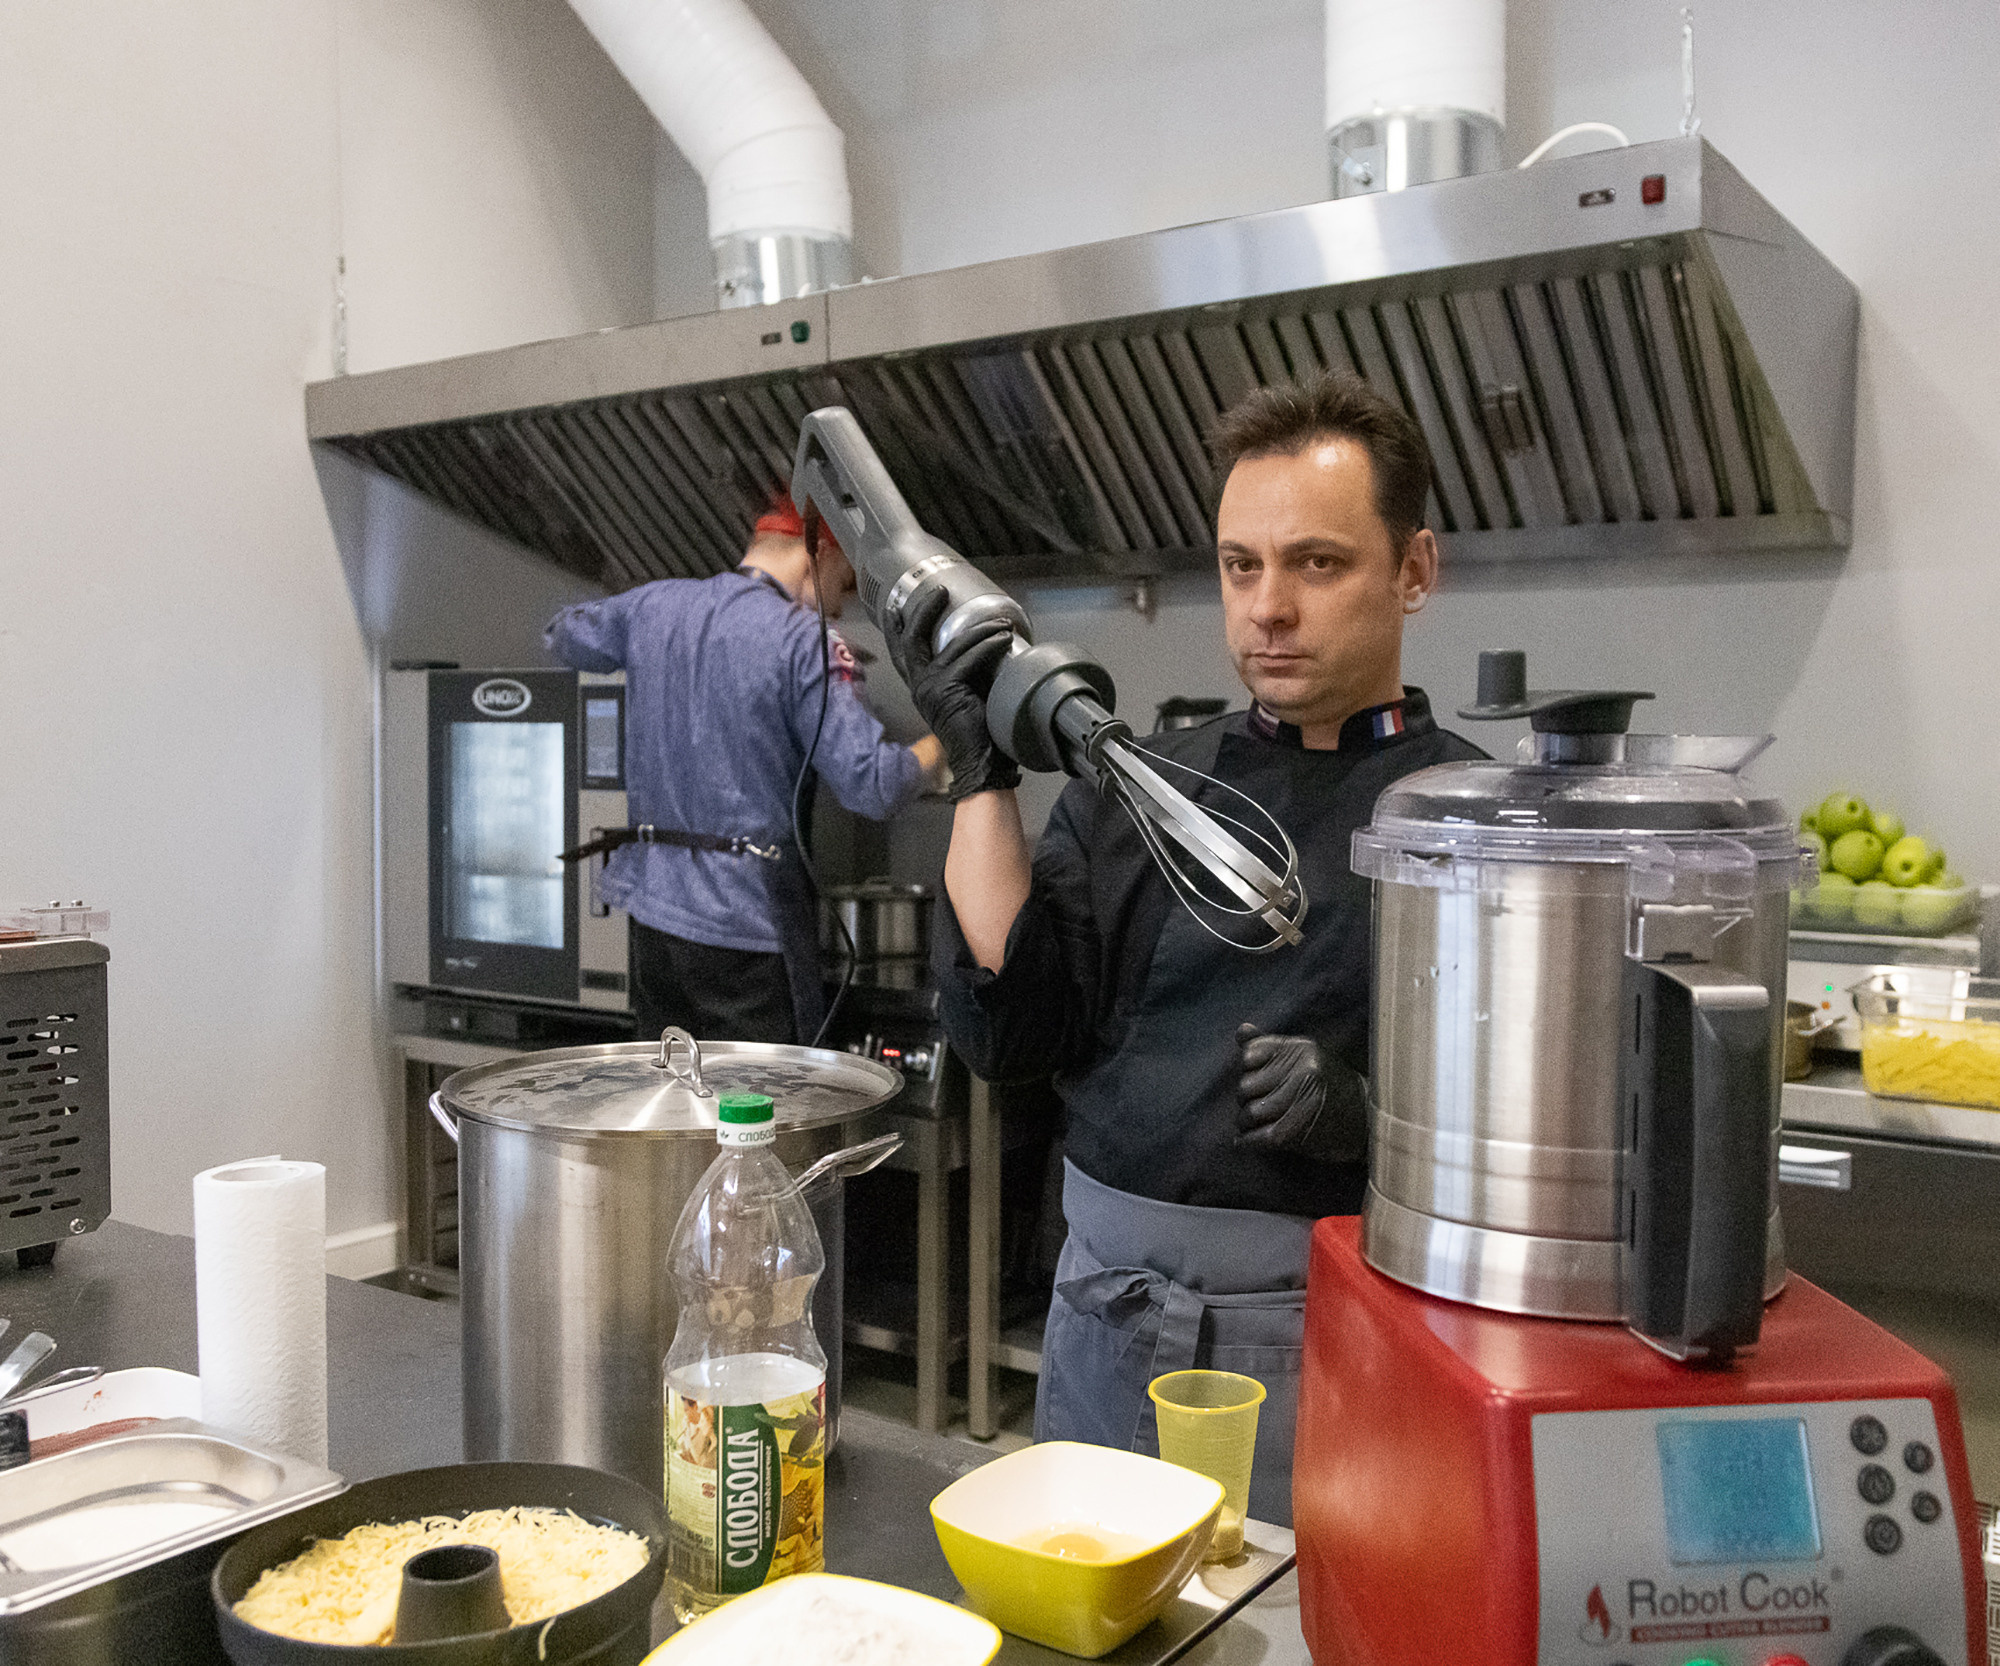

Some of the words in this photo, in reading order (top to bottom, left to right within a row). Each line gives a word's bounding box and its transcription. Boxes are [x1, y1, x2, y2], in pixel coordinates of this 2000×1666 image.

[726, 1428, 759, 1568] СЛОБОДА
[1628, 1578, 1729, 1618] Robot
[1740, 1571, 1829, 1612] Cook
